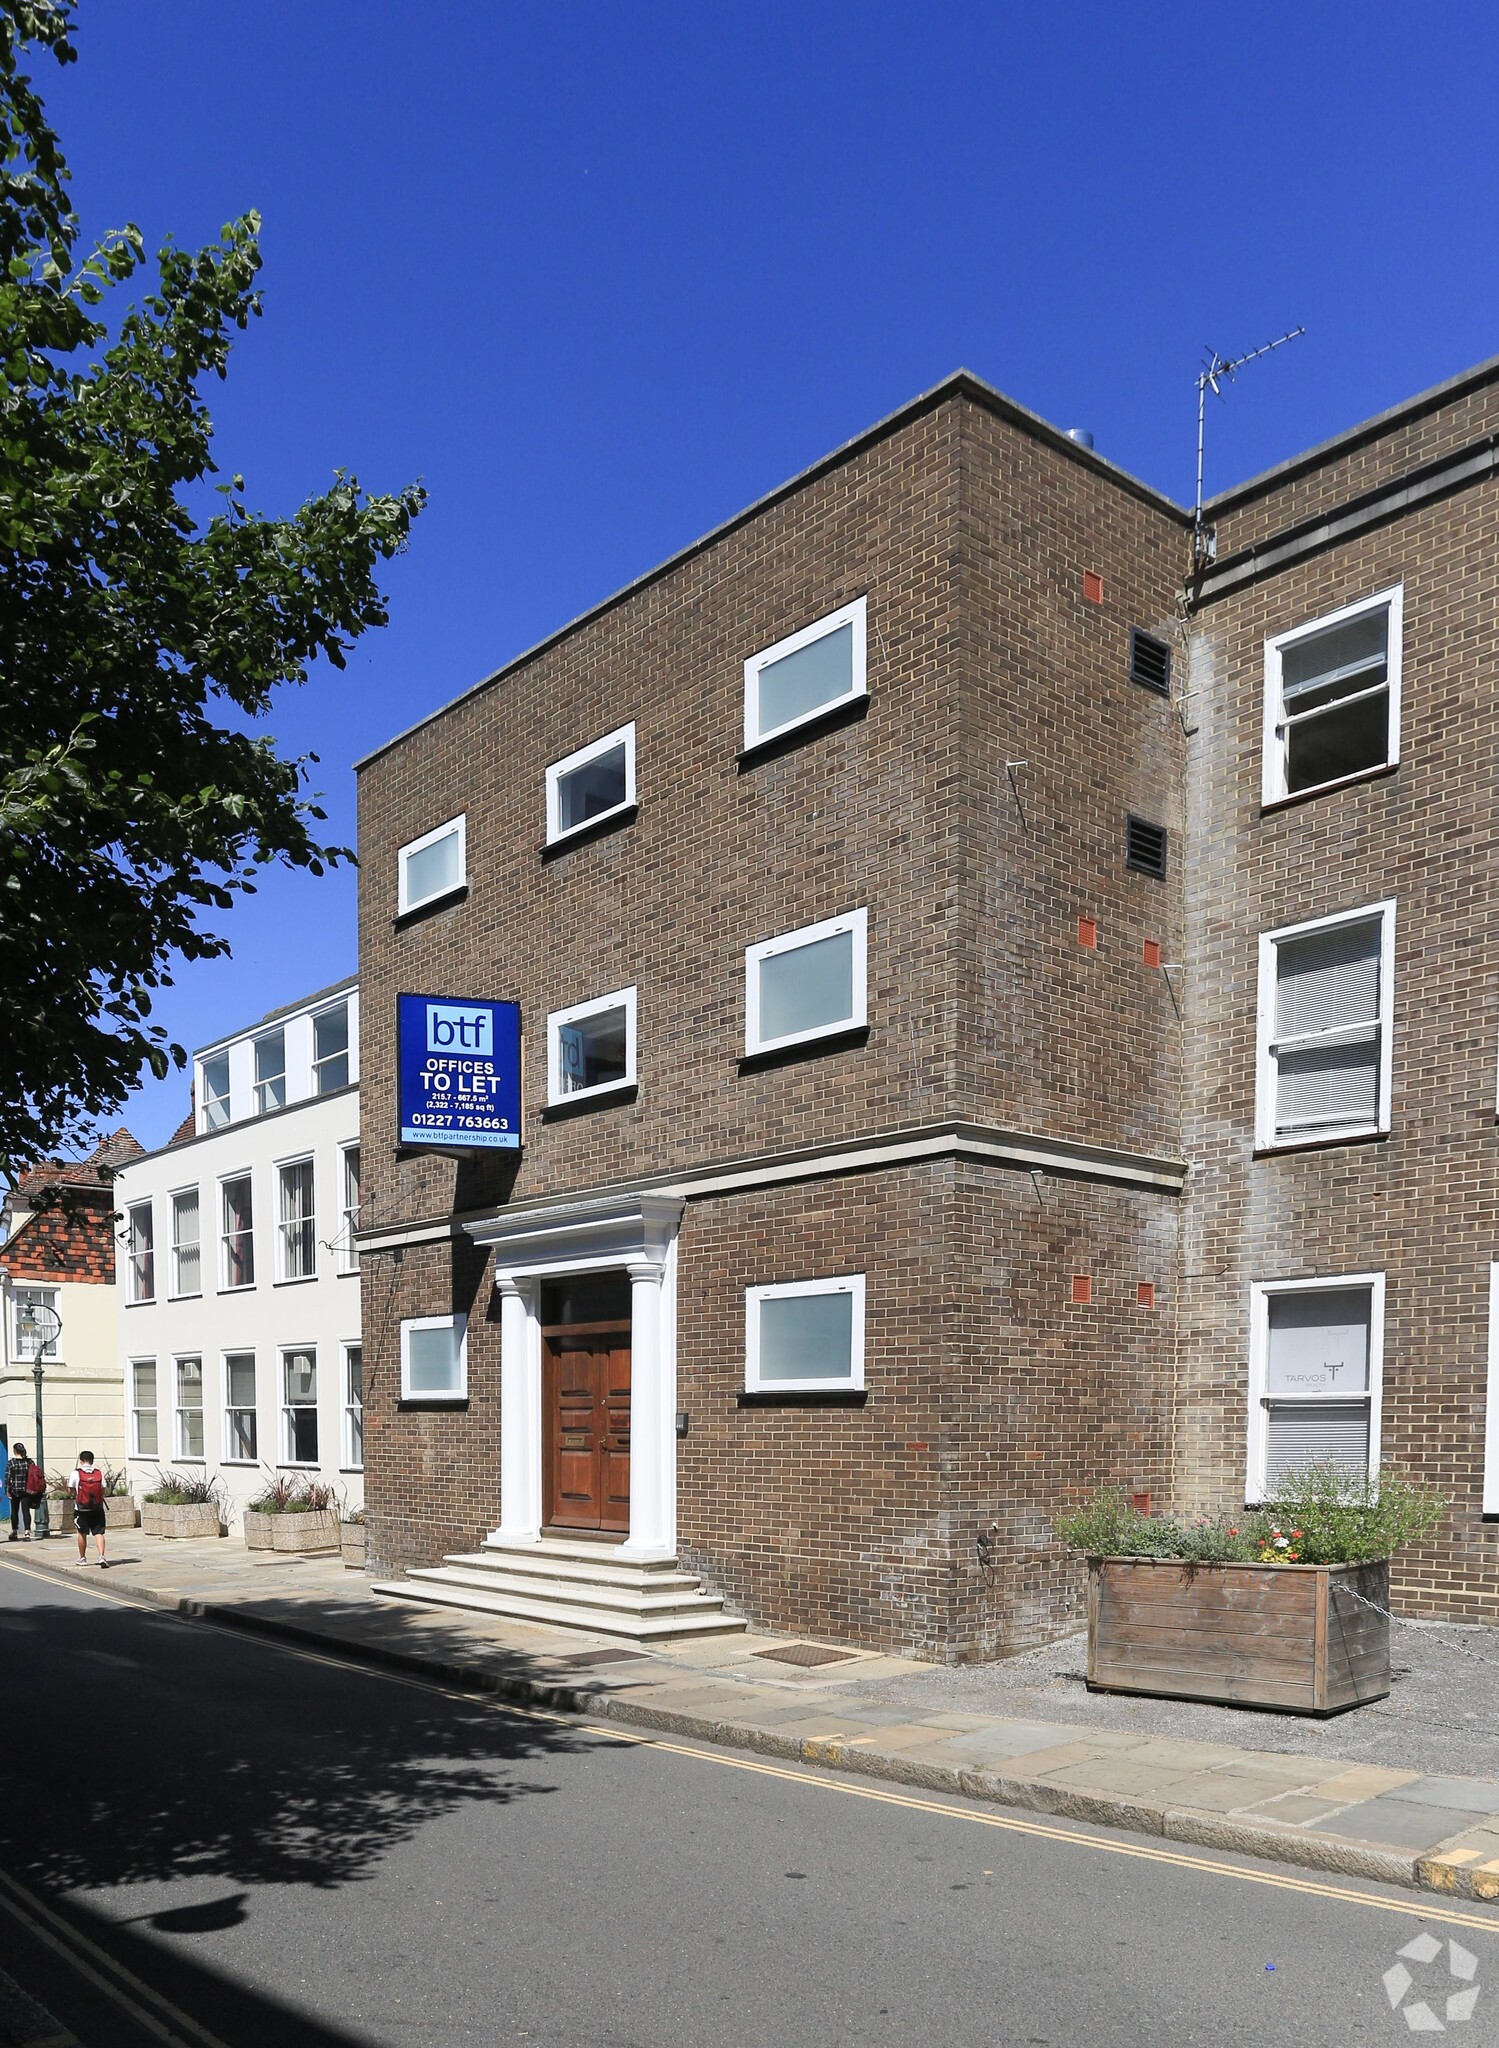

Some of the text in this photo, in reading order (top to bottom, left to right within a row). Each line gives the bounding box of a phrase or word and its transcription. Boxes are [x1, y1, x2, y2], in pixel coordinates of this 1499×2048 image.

[433, 1012, 486, 1048] btf
[426, 1058, 494, 1075] OFFICES
[420, 1072, 501, 1094] TO LET
[431, 1092, 452, 1101] 215.7
[426, 1100, 449, 1109] (2,322
[454, 1102, 475, 1110] 7,185
[475, 1104, 485, 1112] sq
[486, 1104, 495, 1113] ft)
[412, 1113, 509, 1130] 01227 763663
[1284, 1373, 1327, 1382] TARVOS
